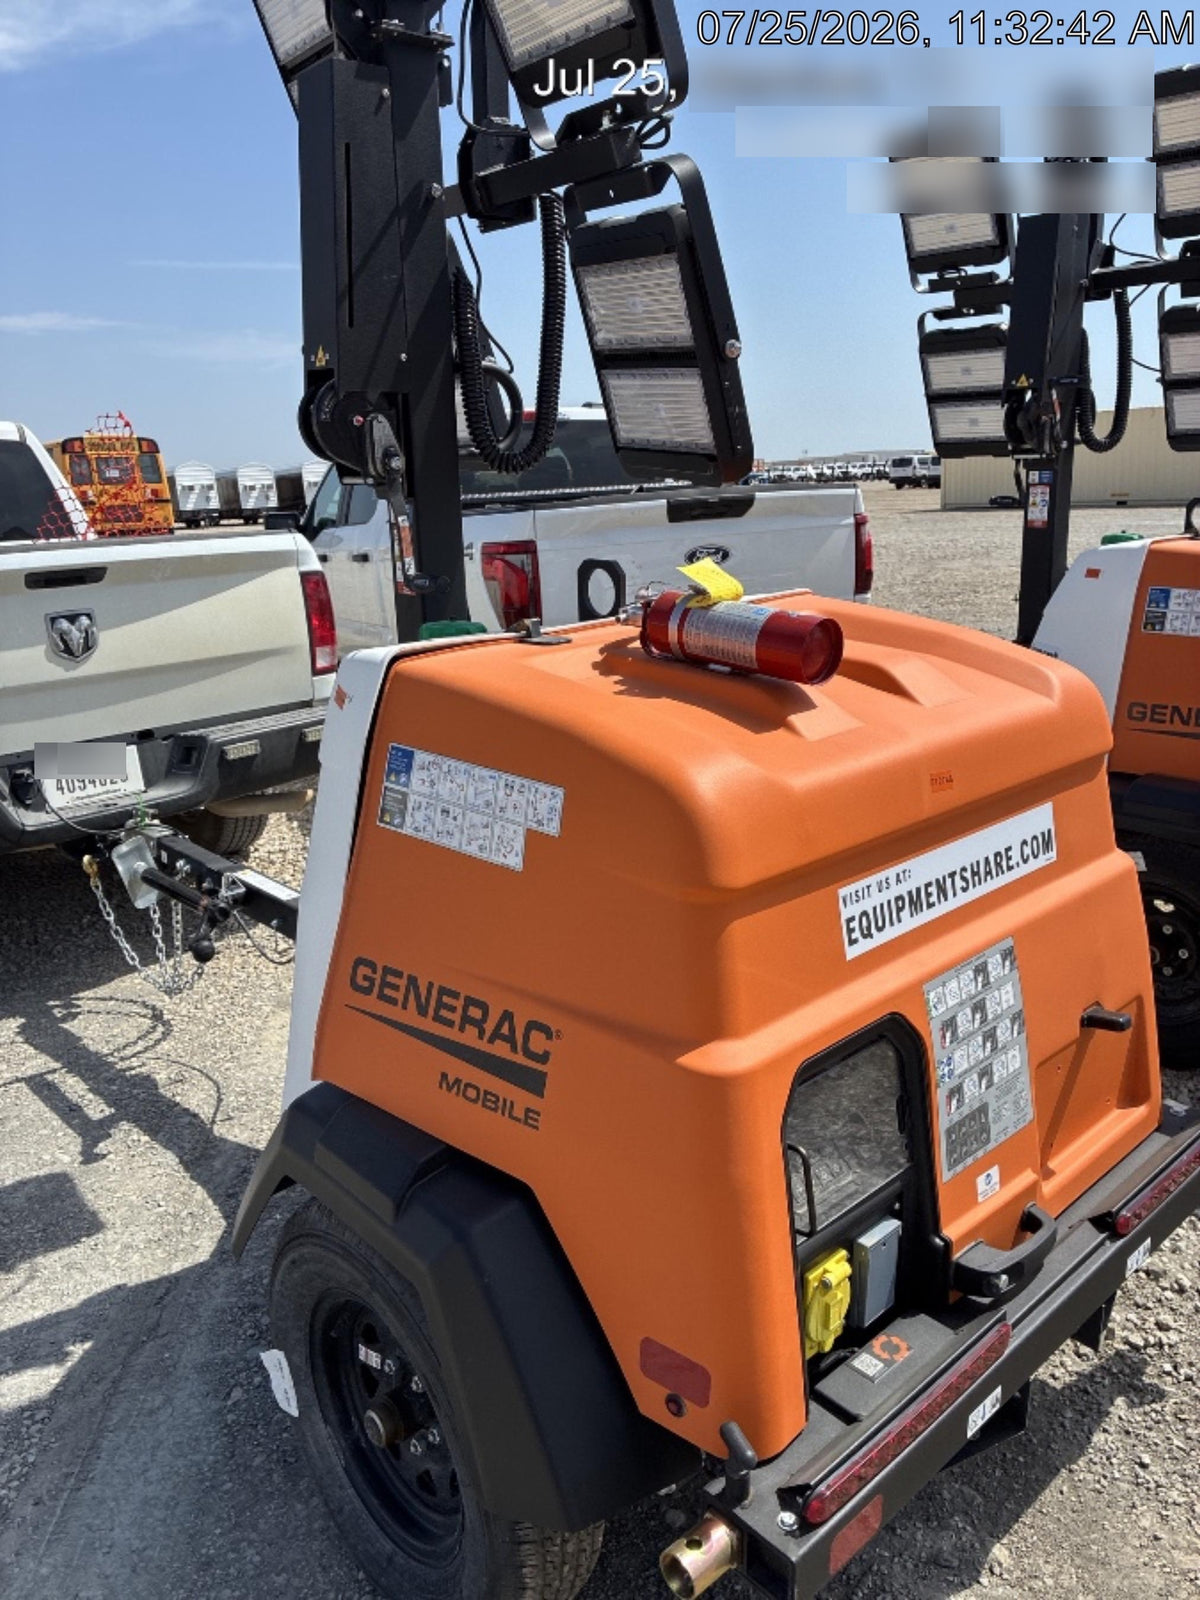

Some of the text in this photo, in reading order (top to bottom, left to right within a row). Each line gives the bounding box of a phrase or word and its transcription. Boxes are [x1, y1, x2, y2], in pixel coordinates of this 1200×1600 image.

[841, 868, 912, 909] VISIT US AT:
[845, 828, 1054, 947] EQUIPMENTSHARE.COM
[350, 956, 554, 1066] GENERAC
[438, 1071, 541, 1131] MOBILE
